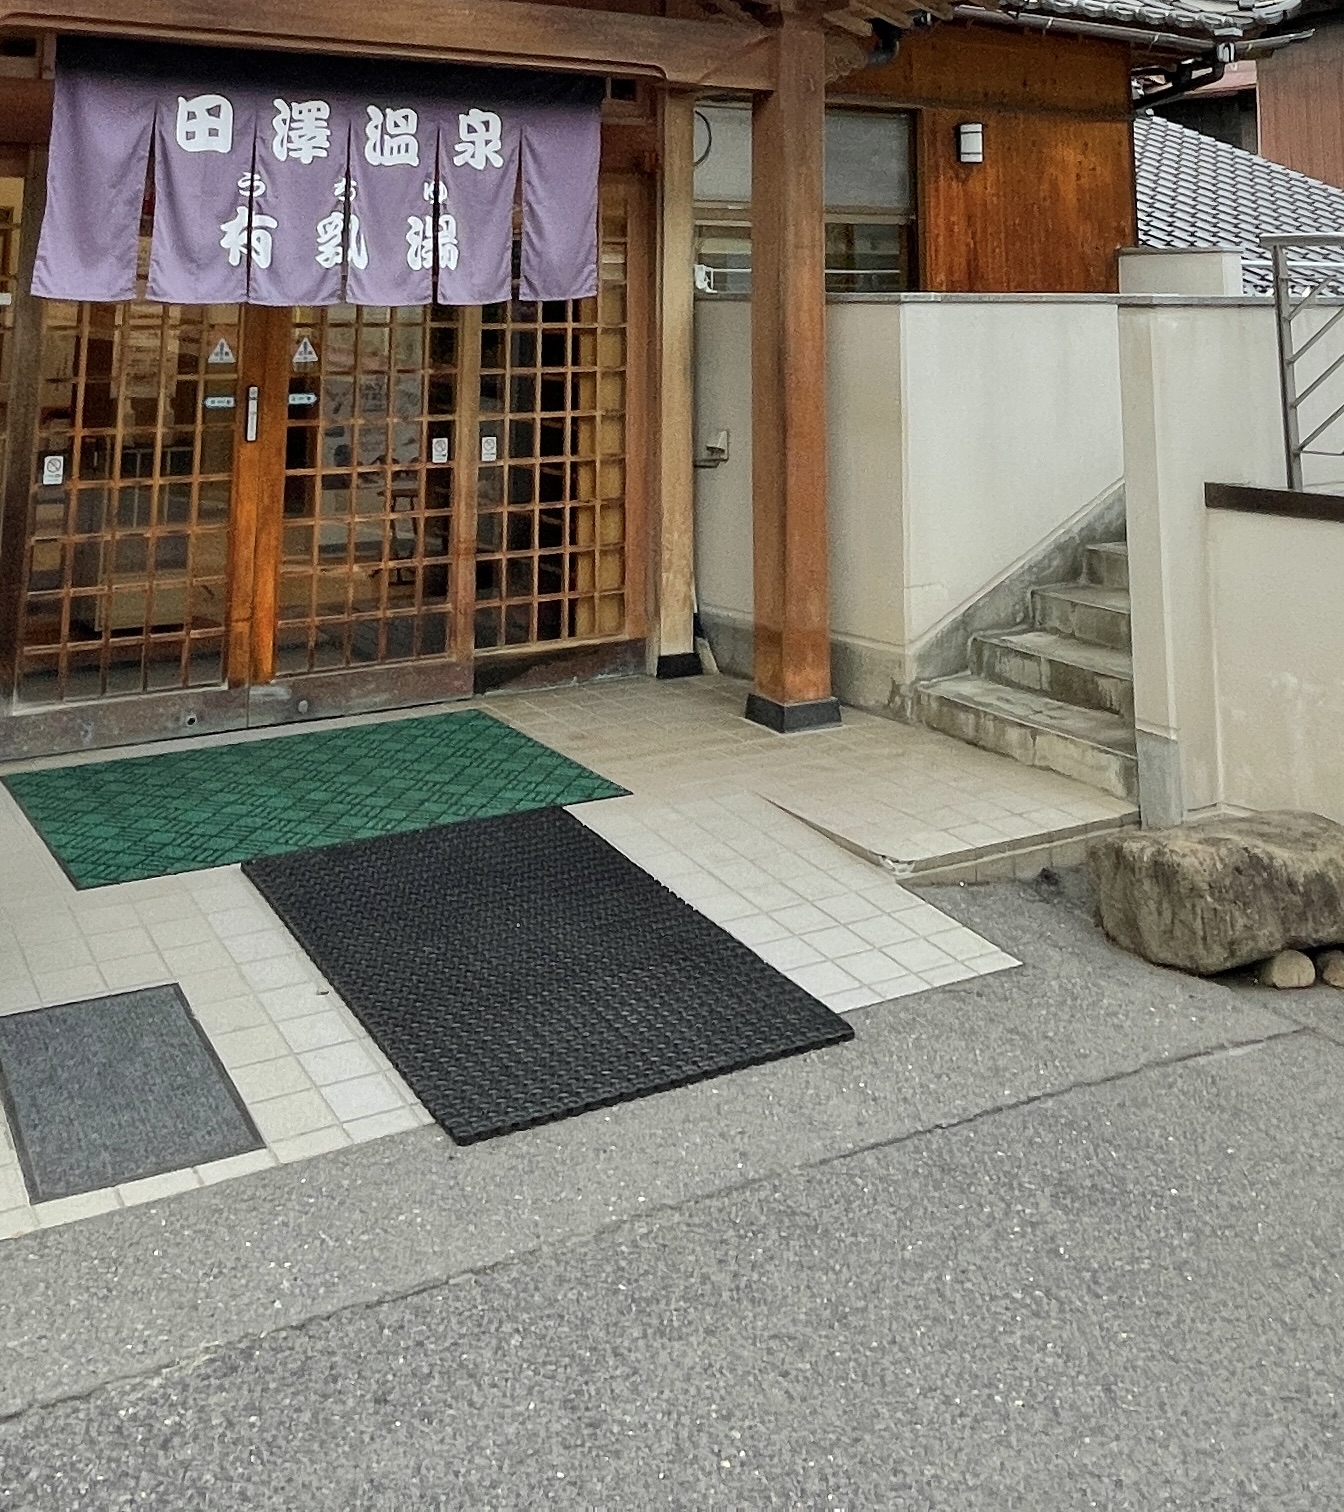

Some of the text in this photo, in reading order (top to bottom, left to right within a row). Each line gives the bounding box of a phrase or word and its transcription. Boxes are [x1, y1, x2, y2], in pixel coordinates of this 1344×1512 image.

[175, 94, 504, 170] 田澤温泉
[219, 206, 460, 272] 有乳湯
